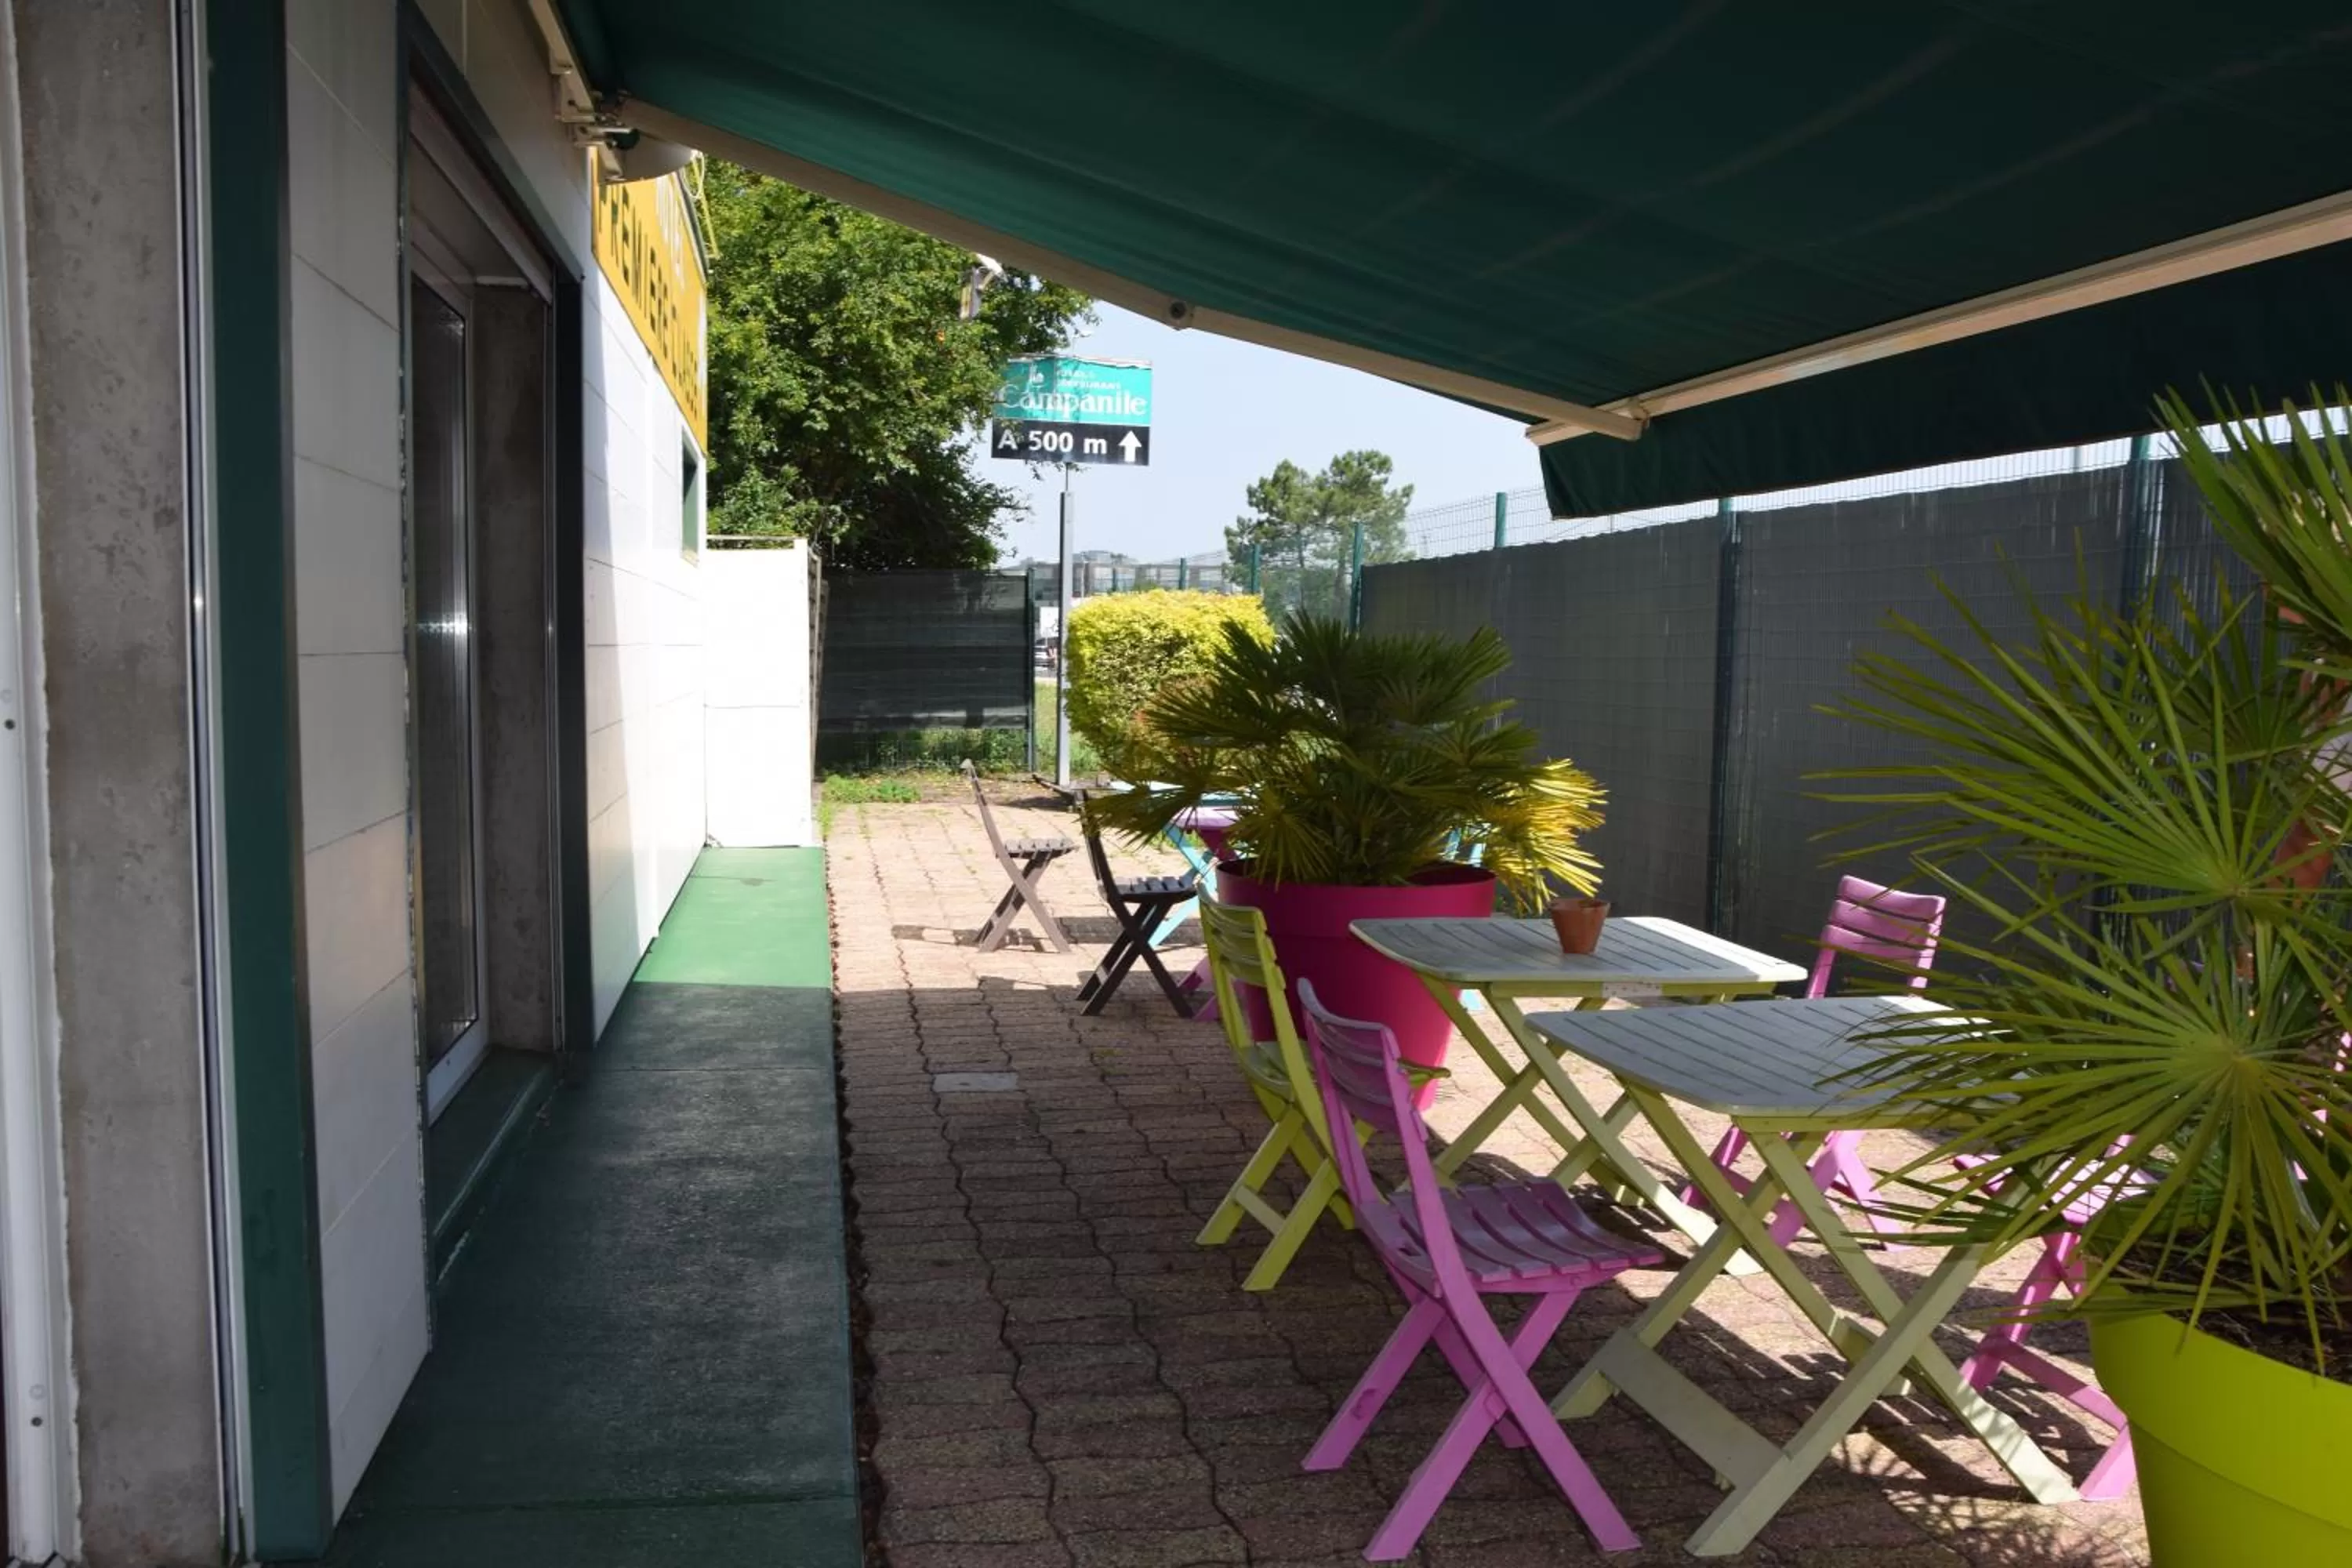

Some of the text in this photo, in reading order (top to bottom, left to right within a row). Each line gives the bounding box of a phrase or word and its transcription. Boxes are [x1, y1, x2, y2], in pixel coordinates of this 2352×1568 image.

[996, 384, 1148, 419] Campanile
[997, 430, 1108, 455] A 500 m
